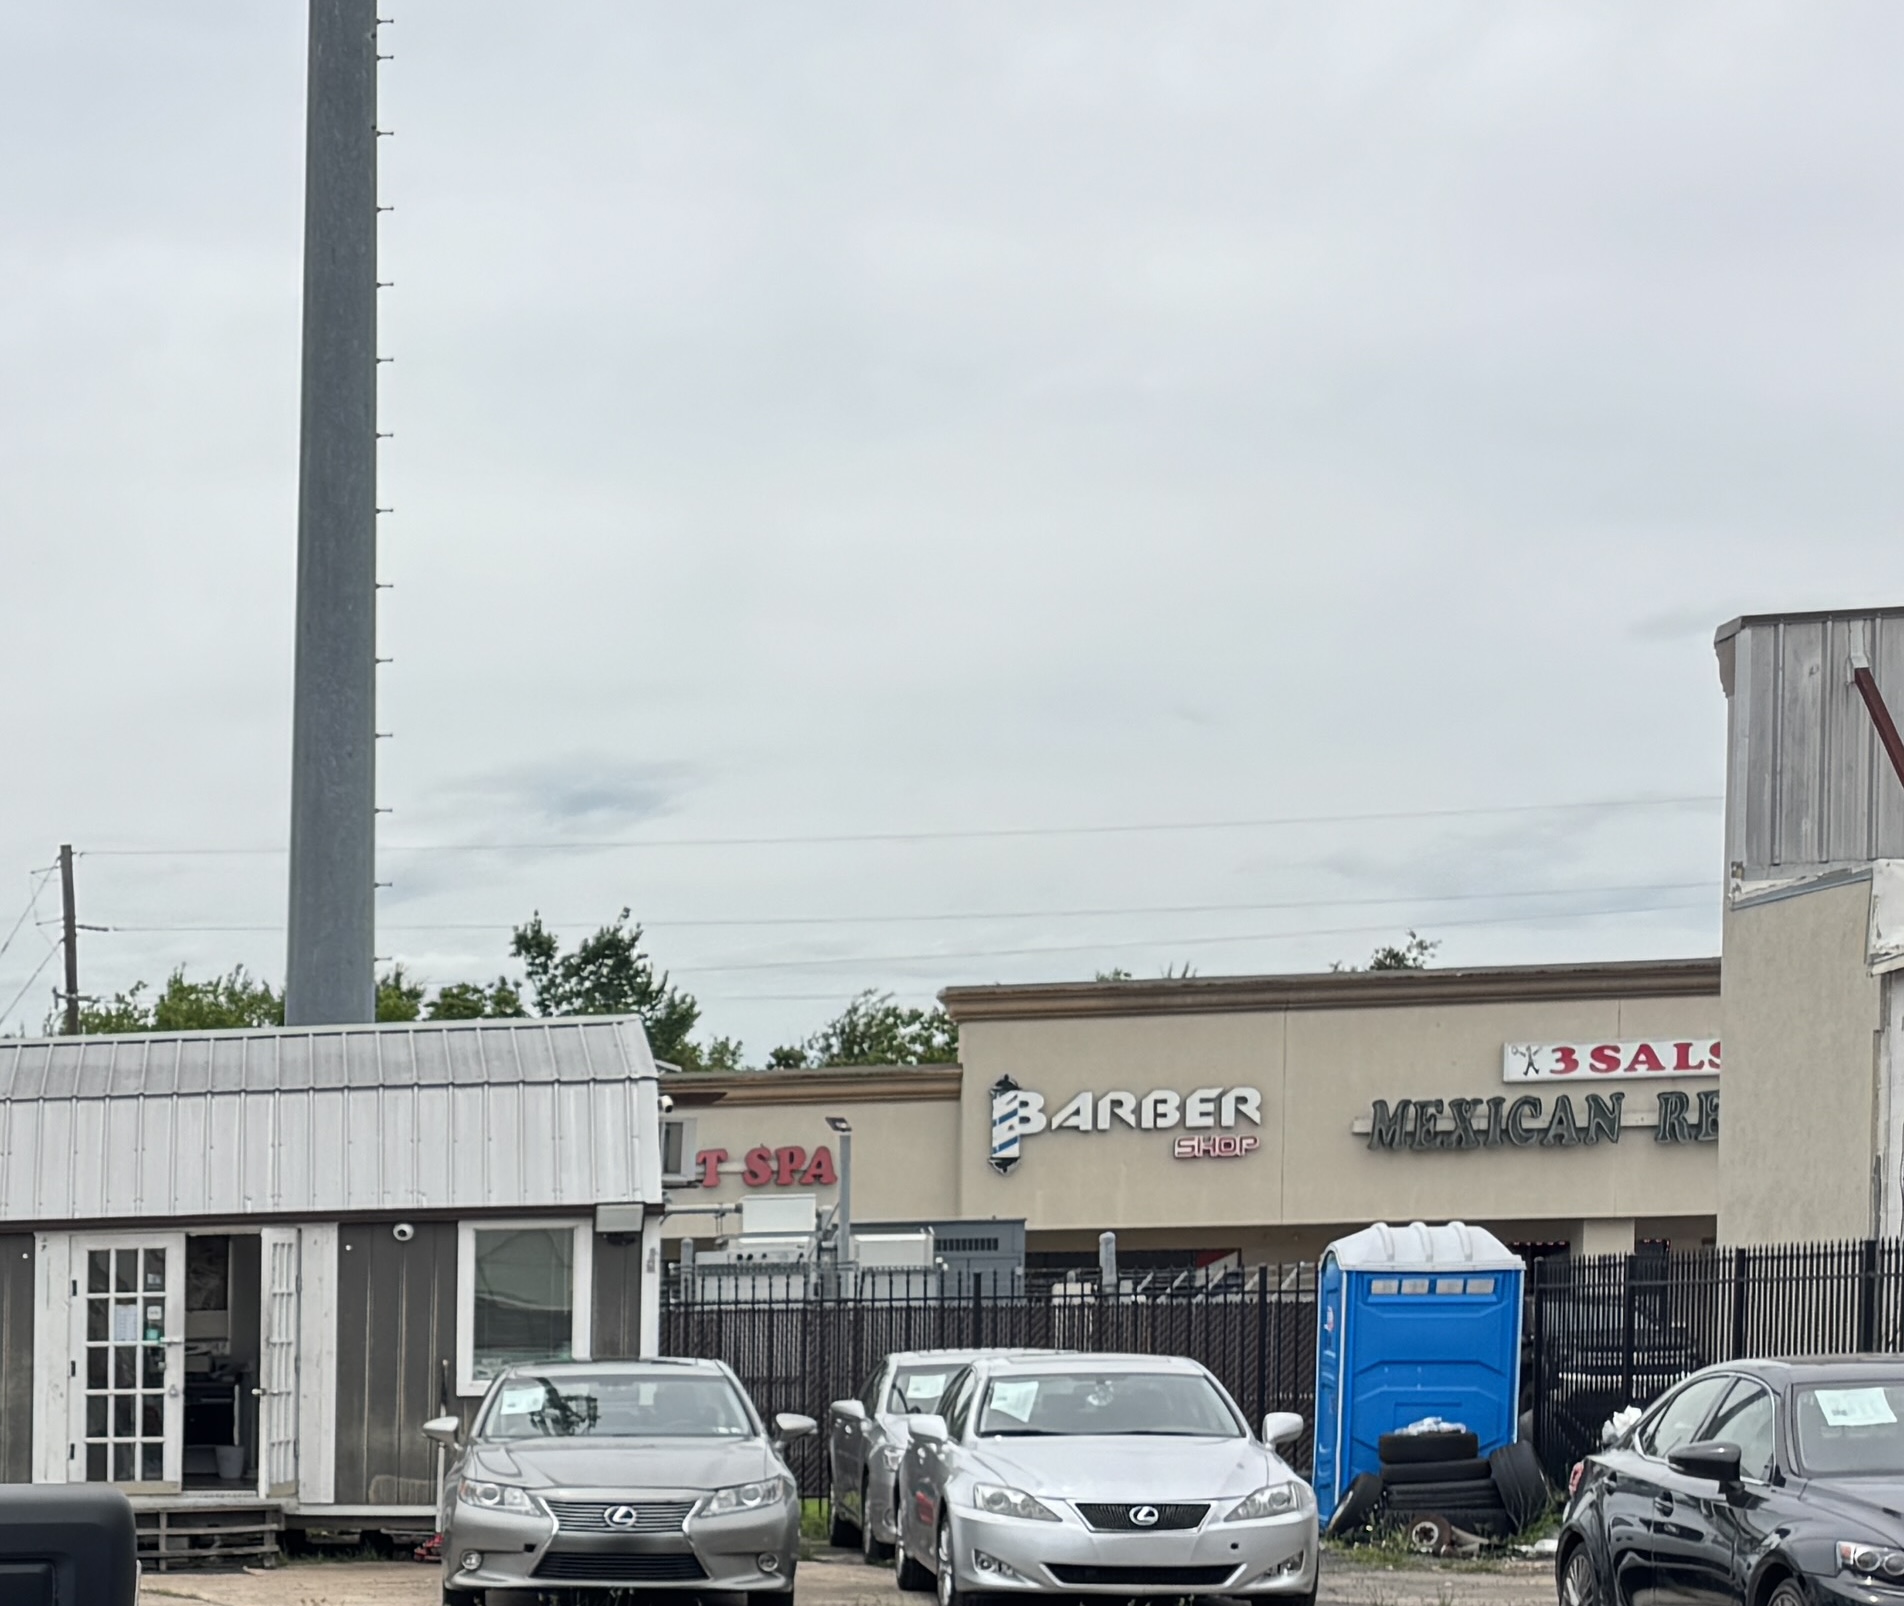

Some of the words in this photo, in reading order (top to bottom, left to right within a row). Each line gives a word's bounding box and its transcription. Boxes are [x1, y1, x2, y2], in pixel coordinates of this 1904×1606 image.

[1549, 1046, 1580, 1075] 3
[992, 1086, 1262, 1136] BARBER
[1367, 1091, 1626, 1150] MEXICAN
[743, 1145, 838, 1187] SPA
[1173, 1135, 1261, 1159] SHOP
